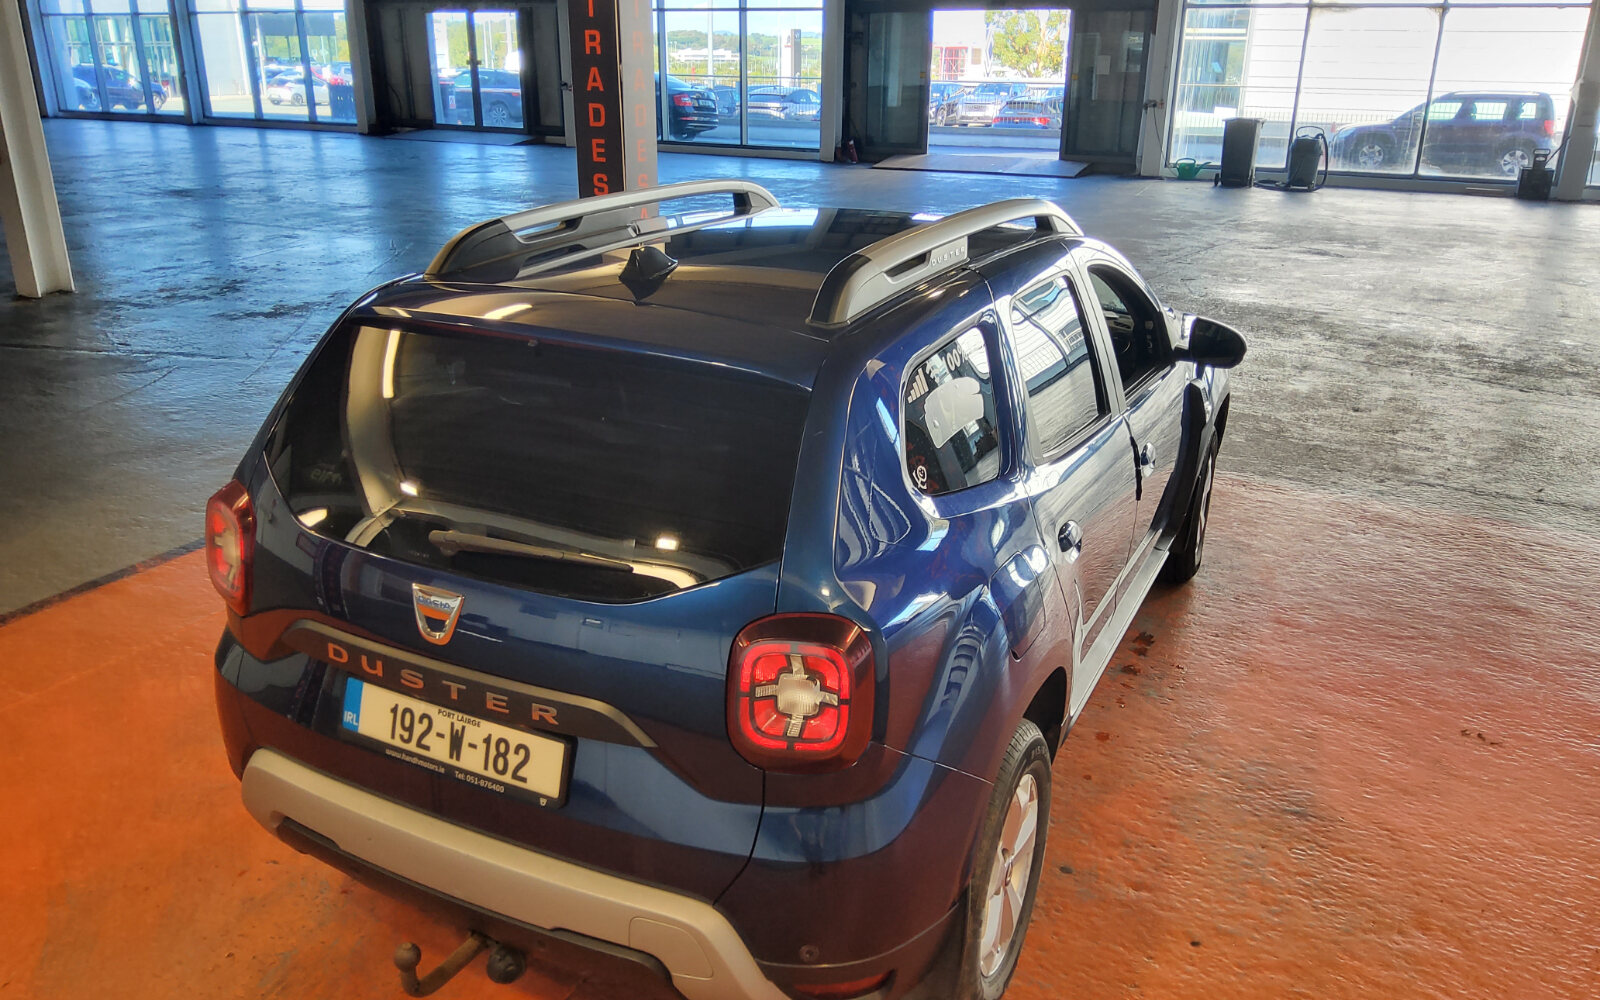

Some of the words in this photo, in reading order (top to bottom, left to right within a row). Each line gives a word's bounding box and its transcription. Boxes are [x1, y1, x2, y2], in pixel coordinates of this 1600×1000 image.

[931, 246, 966, 266] DUSTER
[417, 596, 452, 610] DACIA
[328, 642, 559, 726] DUSTER
[343, 710, 359, 726] IRL
[438, 708, 455, 720] PORT
[389, 703, 532, 784] 192-W-182
